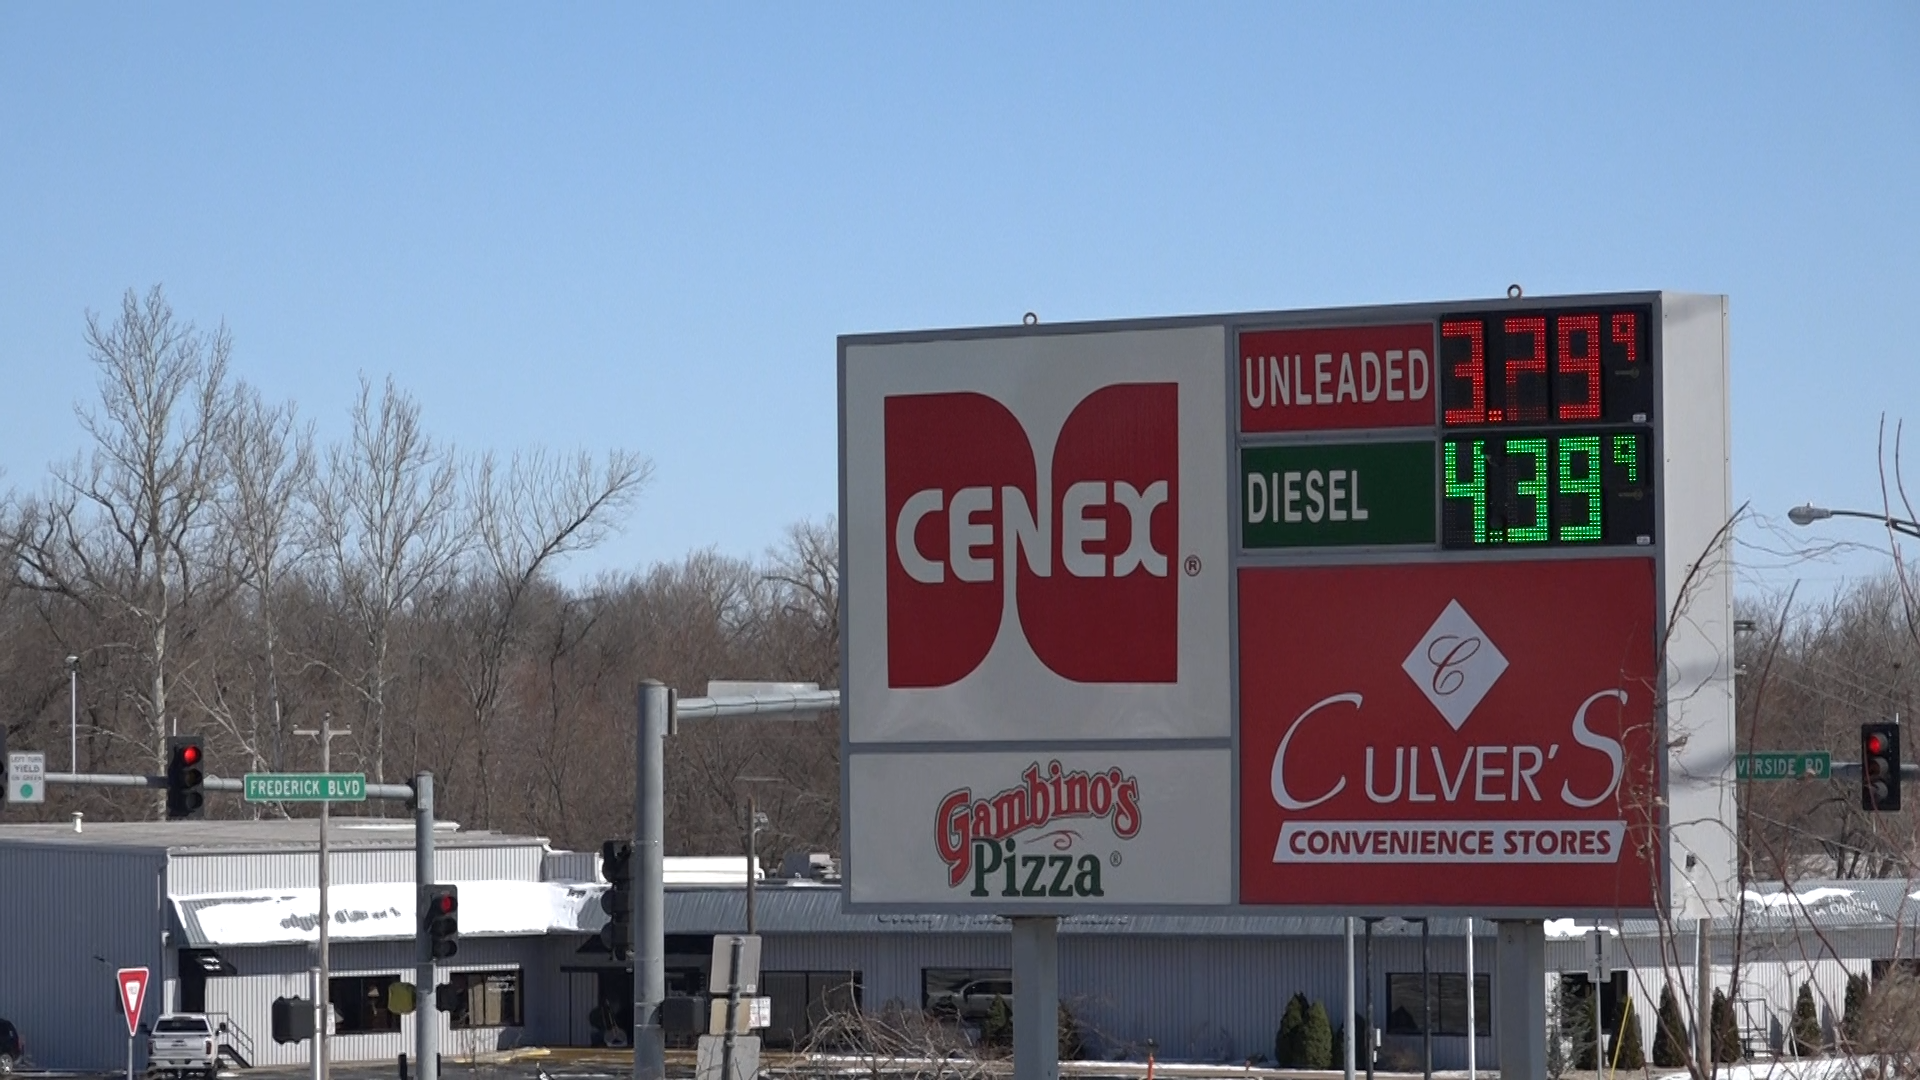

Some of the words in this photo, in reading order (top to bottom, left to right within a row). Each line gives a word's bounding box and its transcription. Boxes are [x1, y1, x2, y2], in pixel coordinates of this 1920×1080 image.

[1245, 348, 1430, 408] UNLEADED
[1441, 314, 1602, 426] 3.29
[1612, 313, 1637, 362] 9
[1247, 470, 1369, 524] DIESEL
[1444, 436, 1602, 544] 4.39
[1613, 435, 1637, 482] 9
[895, 480, 1168, 583] CENEX
[13, 764, 41, 773] YIELD
[1270, 688, 1629, 811] CULVER'S
[1804, 758, 1824, 775] RD
[250, 780, 320, 796] FREDERICK
[327, 780, 360, 796] BLVD
[934, 759, 1142, 888] Gambino's
[1288, 829, 1495, 856] CONVENIENCE
[1503, 829, 1612, 856] STORES
[970, 838, 1105, 897] Pizza
